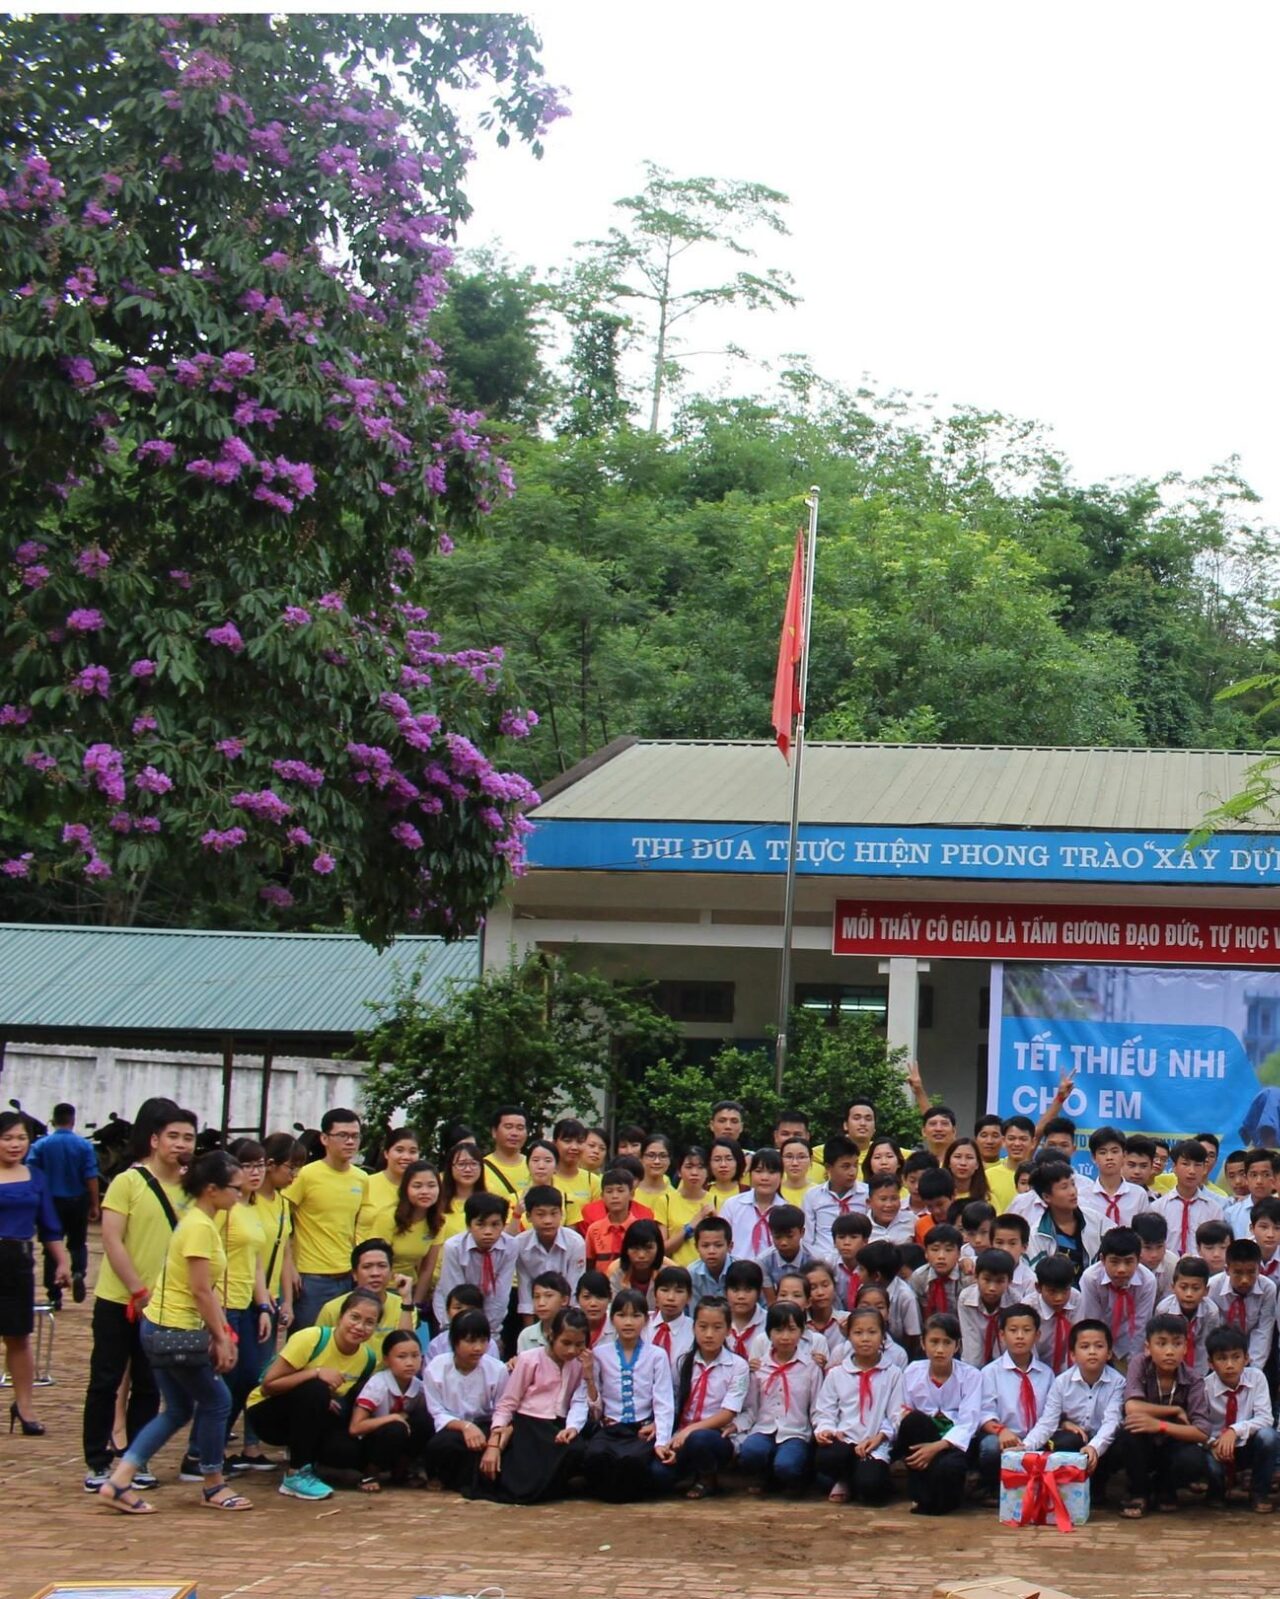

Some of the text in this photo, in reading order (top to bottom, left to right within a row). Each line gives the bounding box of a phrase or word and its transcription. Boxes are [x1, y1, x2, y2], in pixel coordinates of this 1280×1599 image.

[632, 837, 683, 859] THI
[766, 838, 845, 867] THỰC
[853, 837, 931, 869] HIỆN
[940, 844, 1050, 867] PHONG
[926, 914, 949, 942] CÔ
[951, 914, 991, 943] GIÁO
[996, 915, 1017, 943] LÀ
[1062, 920, 1120, 946] GƯƠNG
[1125, 923, 1160, 950] ĐẠO
[1165, 918, 1204, 949] ĐỨC,
[1209, 923, 1233, 953] TỰ
[1234, 926, 1269, 953] HỌC
[1013, 1030, 1226, 1079] TẾT THIẾU NHI
[1011, 1084, 1142, 1120] CHO EM
